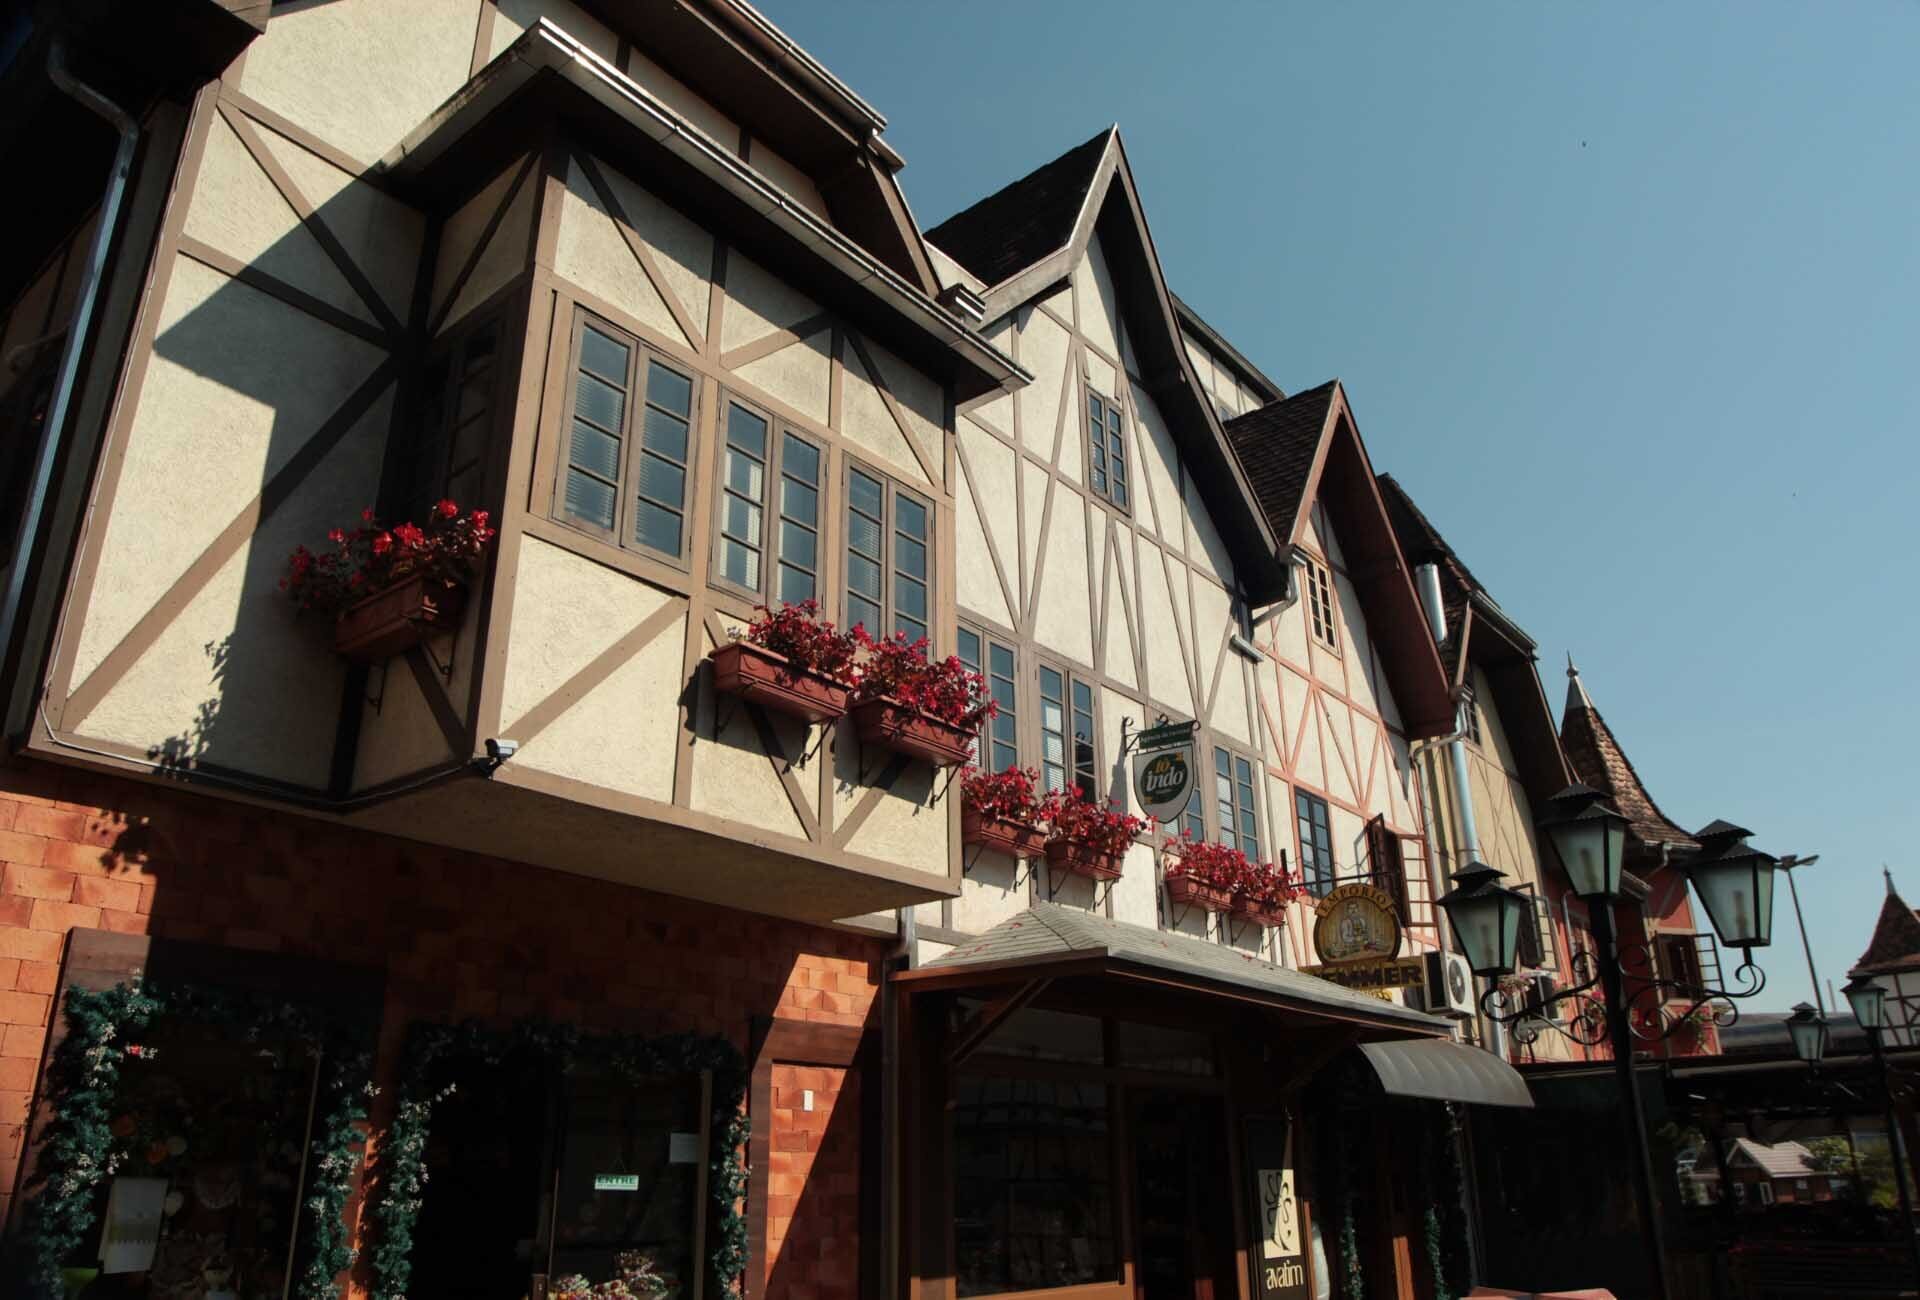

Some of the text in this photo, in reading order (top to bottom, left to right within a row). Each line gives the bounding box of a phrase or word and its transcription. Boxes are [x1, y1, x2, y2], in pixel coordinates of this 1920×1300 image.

[1146, 766, 1183, 792] indo
[596, 1175, 635, 1185] ENTRE
[1266, 1259, 1304, 1290] avatim
